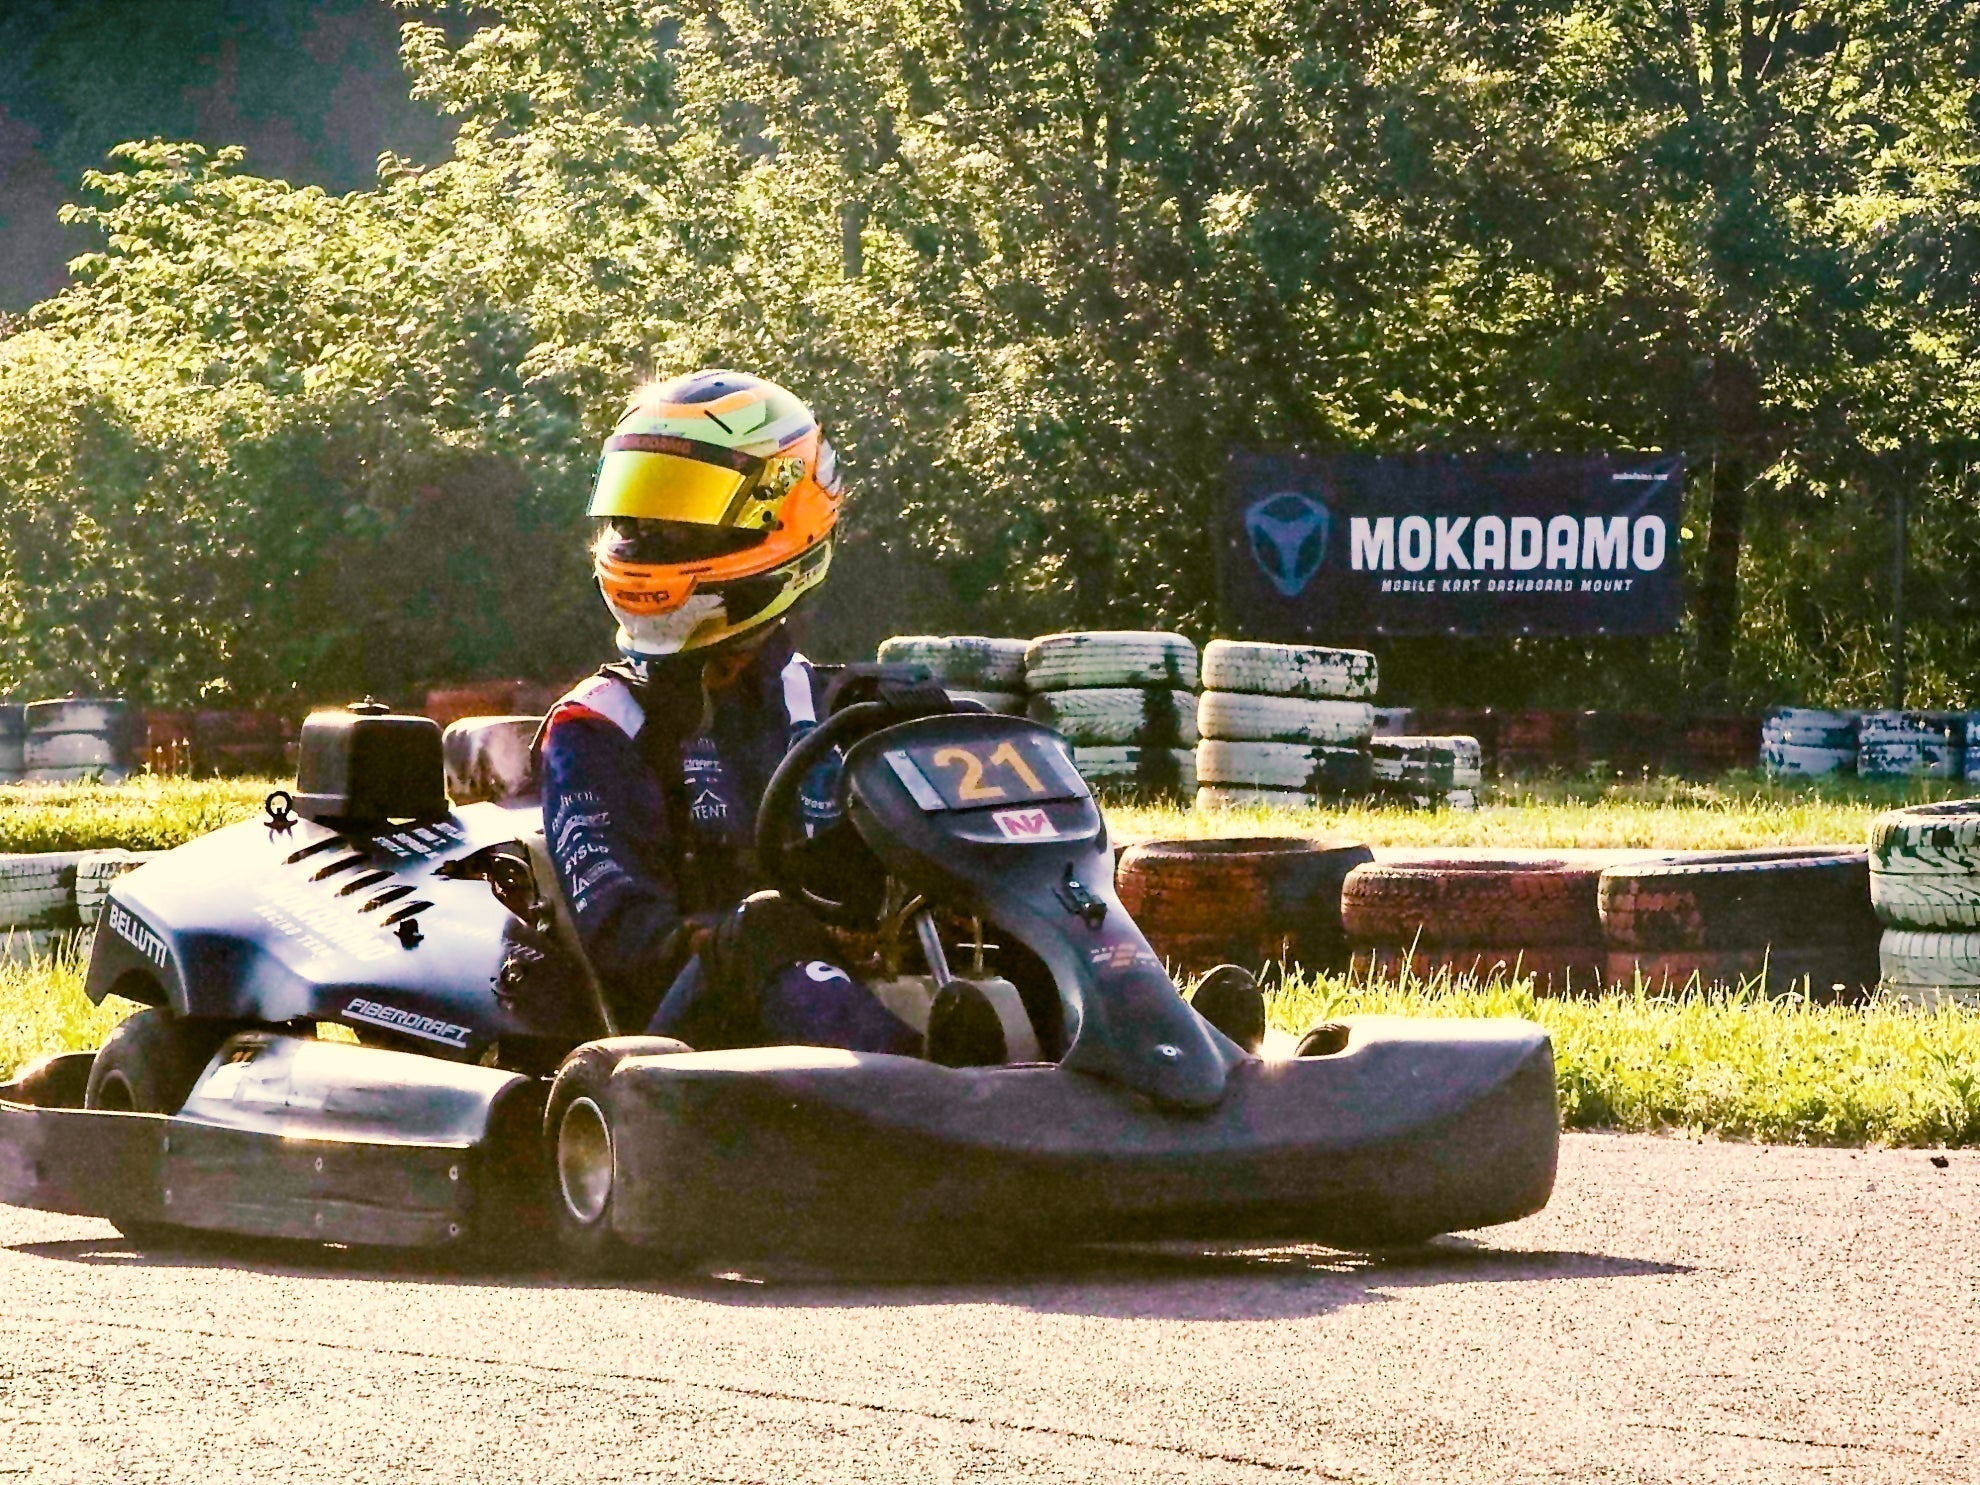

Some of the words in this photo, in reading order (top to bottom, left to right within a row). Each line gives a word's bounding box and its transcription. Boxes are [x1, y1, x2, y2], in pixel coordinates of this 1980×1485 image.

[1350, 514, 1666, 571] MOKADAMO
[1382, 579, 1435, 592] MOBILE
[1443, 579, 1481, 592] KART
[1488, 579, 1573, 592] DASHBOARD
[1580, 579, 1634, 592] MOUNT
[933, 742, 1046, 801] 21
[108, 904, 167, 968] BELLUTTI
[346, 997, 472, 1042] FIBERDRAFT
